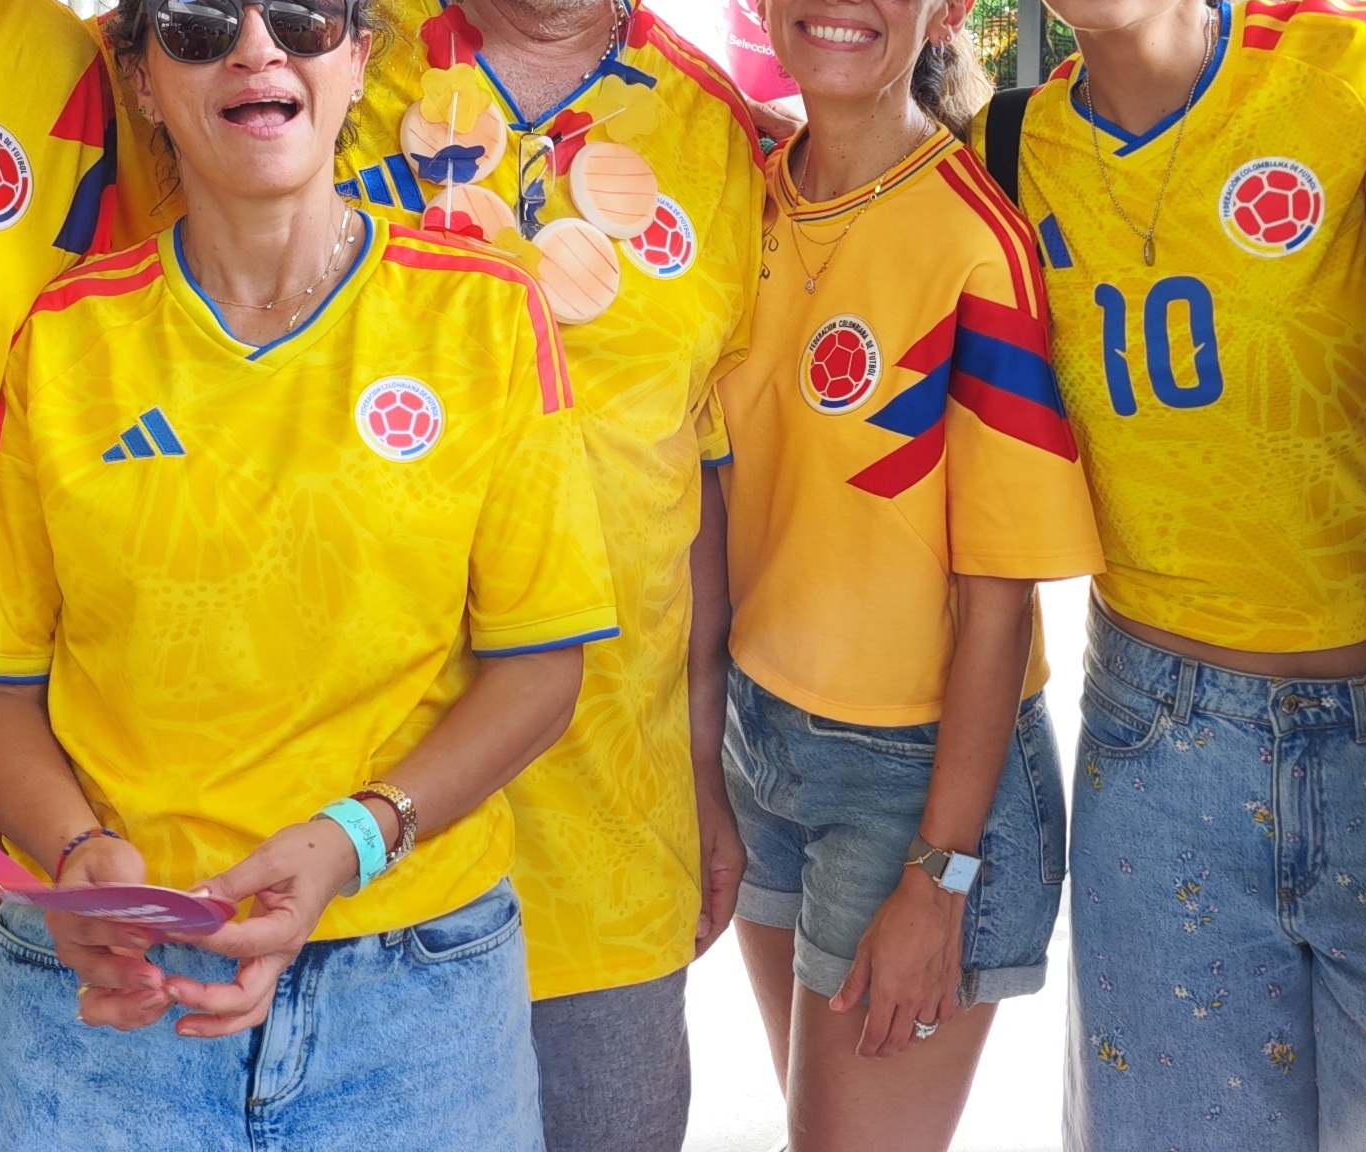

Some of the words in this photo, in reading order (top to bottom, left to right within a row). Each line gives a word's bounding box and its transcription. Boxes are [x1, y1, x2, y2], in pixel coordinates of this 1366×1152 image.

[3, 137, 13, 149] DE
[1240, 161, 1288, 178] COLOMBIANA
[839, 320, 868, 340] COLOMBIANA
[866, 340, 874, 349] DE
[1095, 275, 1223, 417] 10
[867, 352, 876, 376] FUTBOL
